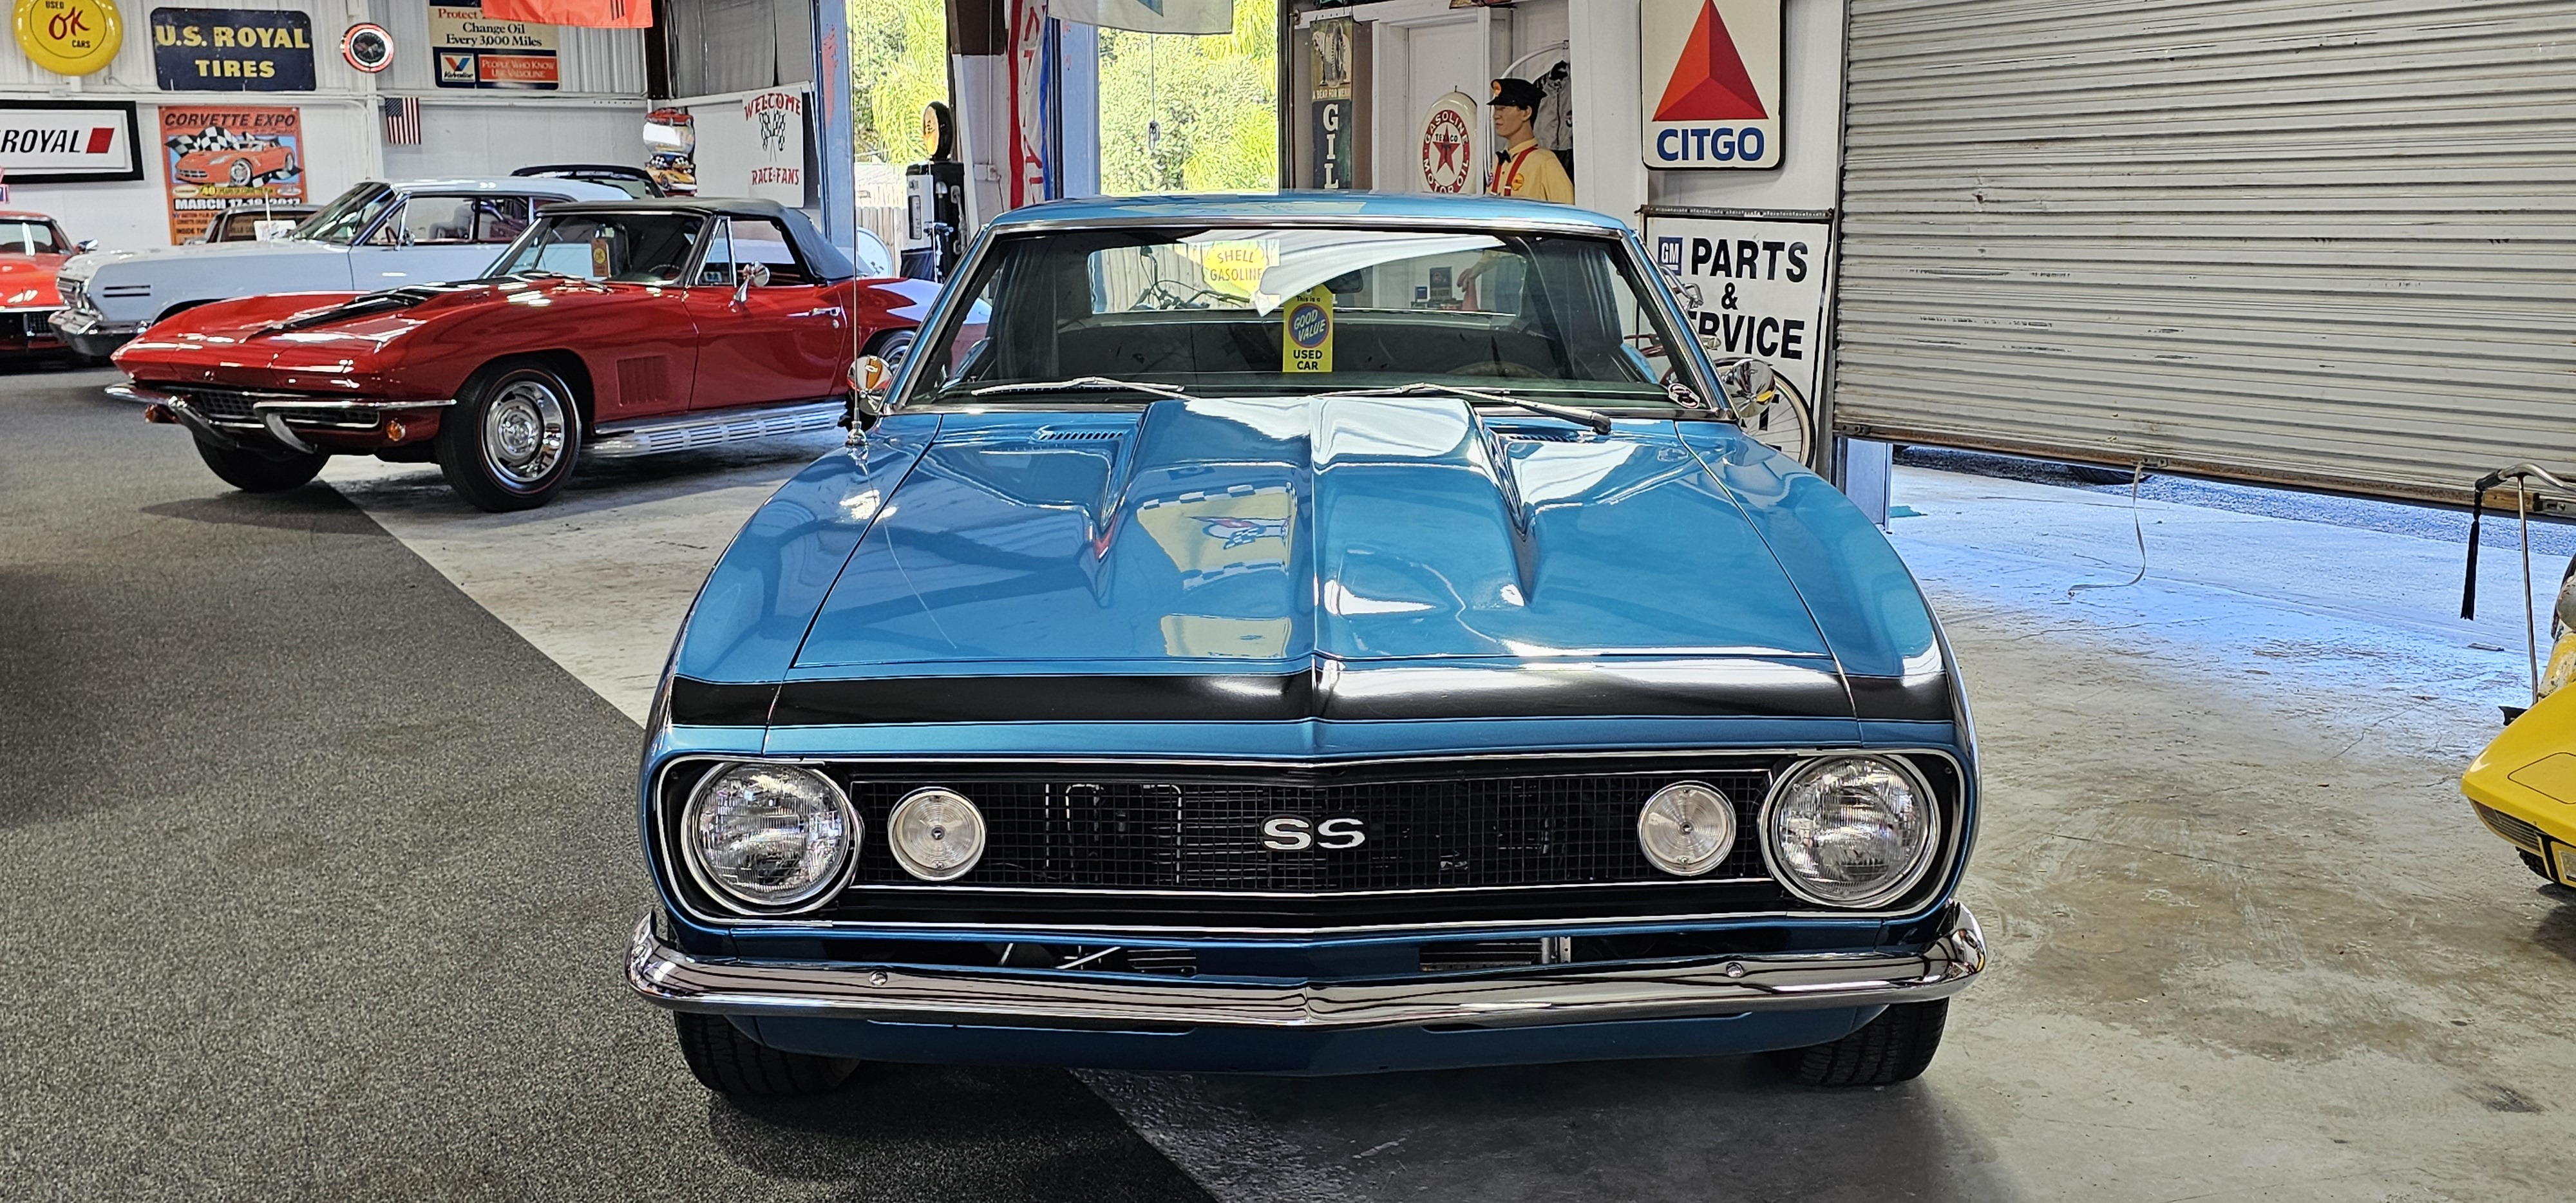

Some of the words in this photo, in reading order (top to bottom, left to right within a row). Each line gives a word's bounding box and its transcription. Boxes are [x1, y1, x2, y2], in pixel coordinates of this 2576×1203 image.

[46, 1, 64, 9] USED
[438, 8, 480, 19] Protect
[49, 6, 90, 40] OK
[462, 22, 506, 34] Change
[507, 23, 525, 33] Oil
[72, 40, 90, 48] CARS
[155, 25, 207, 47] U.S.
[213, 26, 310, 48] ROYAL
[446, 33, 477, 46] Every
[480, 35, 509, 46] 3,000
[512, 36, 542, 46] Miles
[194, 60, 275, 78] TIRES
[744, 93, 800, 122] WELCOME
[165, 113, 249, 126] CORVETTE
[254, 113, 295, 126] EXPO
[1425, 111, 1468, 144] GASOLINE
[0, 129, 80, 153] ROYAL
[1656, 127, 1765, 162] CITGO
[752, 167, 773, 185] RACE
[776, 168, 799, 185] FANS
[1423, 158, 1454, 193] MOTOR
[1457, 160, 1468, 187] OIL
[175, 199, 226, 209] MARCH
[1217, 250, 1253, 263] SHELL
[1661, 242, 1680, 264] GM
[1691, 238, 1808, 283] PARTS
[1211, 268, 1262, 281] GASOLINE
[1721, 282, 1738, 310] &
[1294, 309, 1318, 330] GOOD
[1298, 319, 1326, 342] VALUE
[1688, 310, 1805, 360] RVICE
[1293, 350, 1322, 359] USED
[1297, 361, 1319, 370] CAR
[1264, 819, 1365, 850] SS
